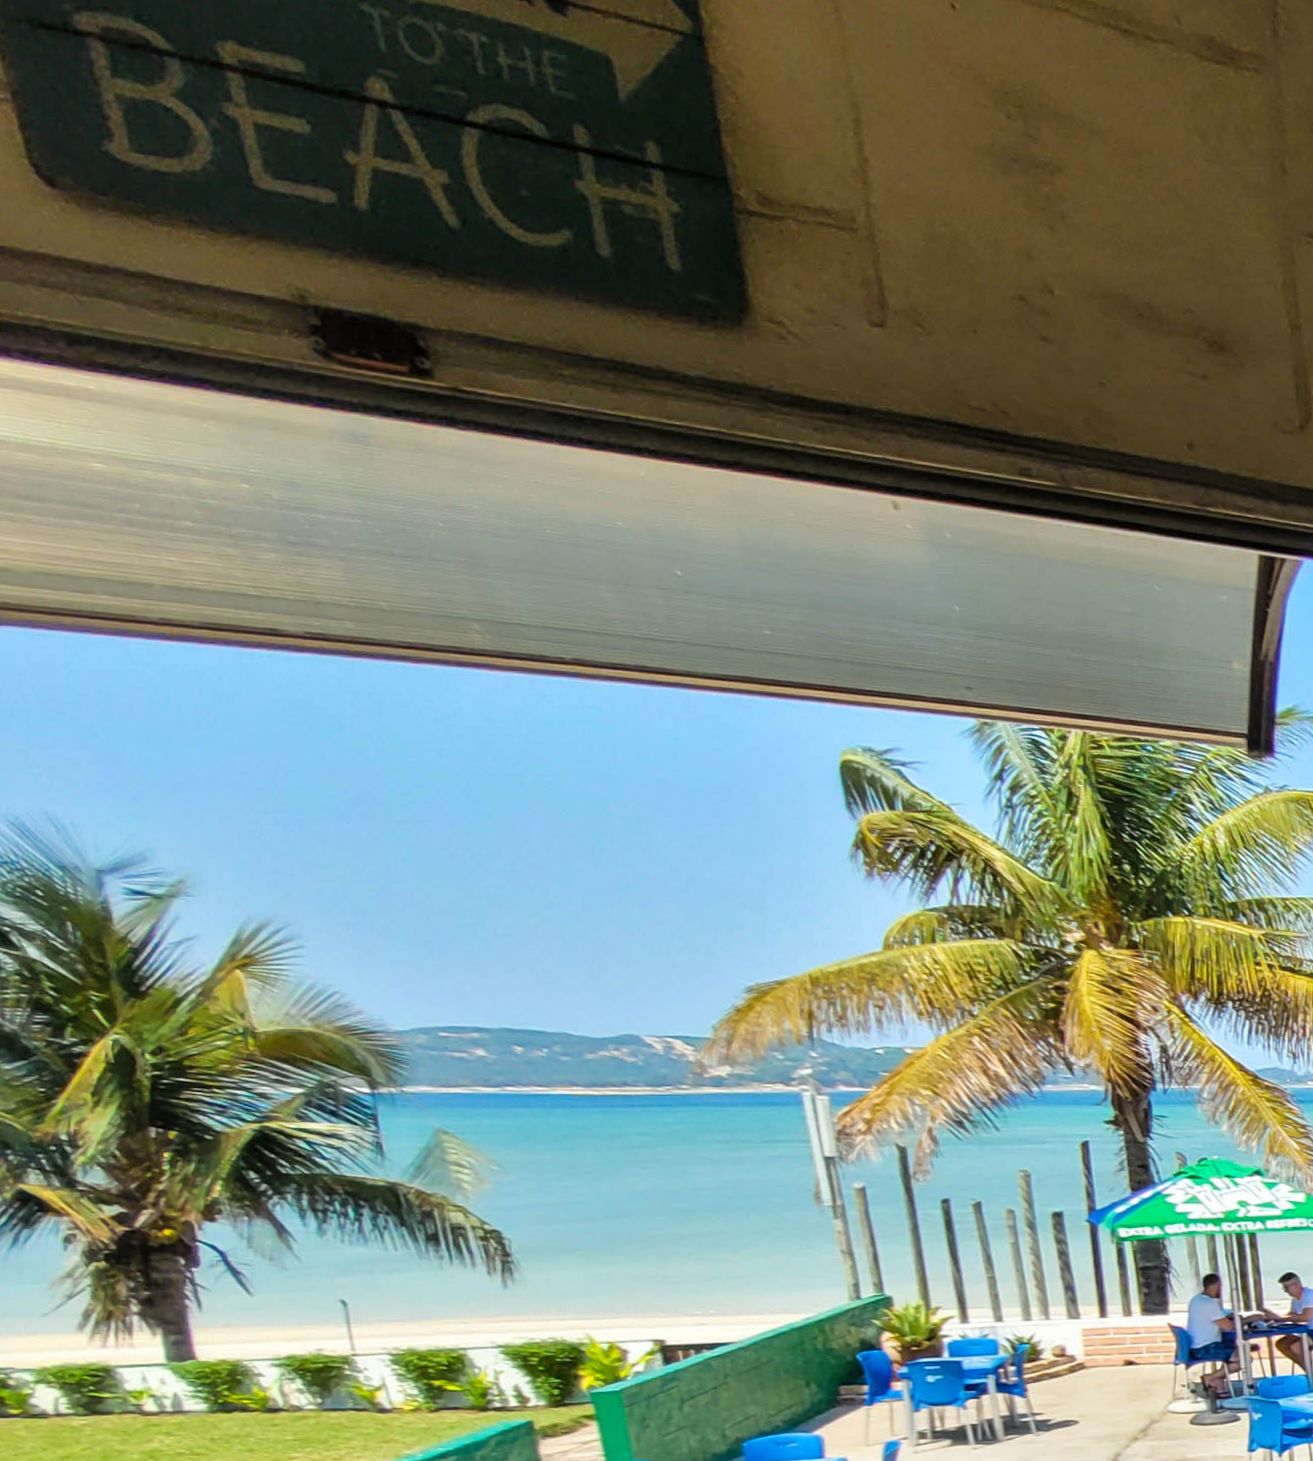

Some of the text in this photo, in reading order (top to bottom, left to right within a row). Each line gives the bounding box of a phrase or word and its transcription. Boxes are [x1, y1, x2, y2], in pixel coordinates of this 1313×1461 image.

[361, 3, 577, 100] TO THE
[72, 9, 682, 272] BEACH
[1118, 1226, 1164, 1238] EXTRA
[1221, 1221, 1264, 1232] EXTRA
